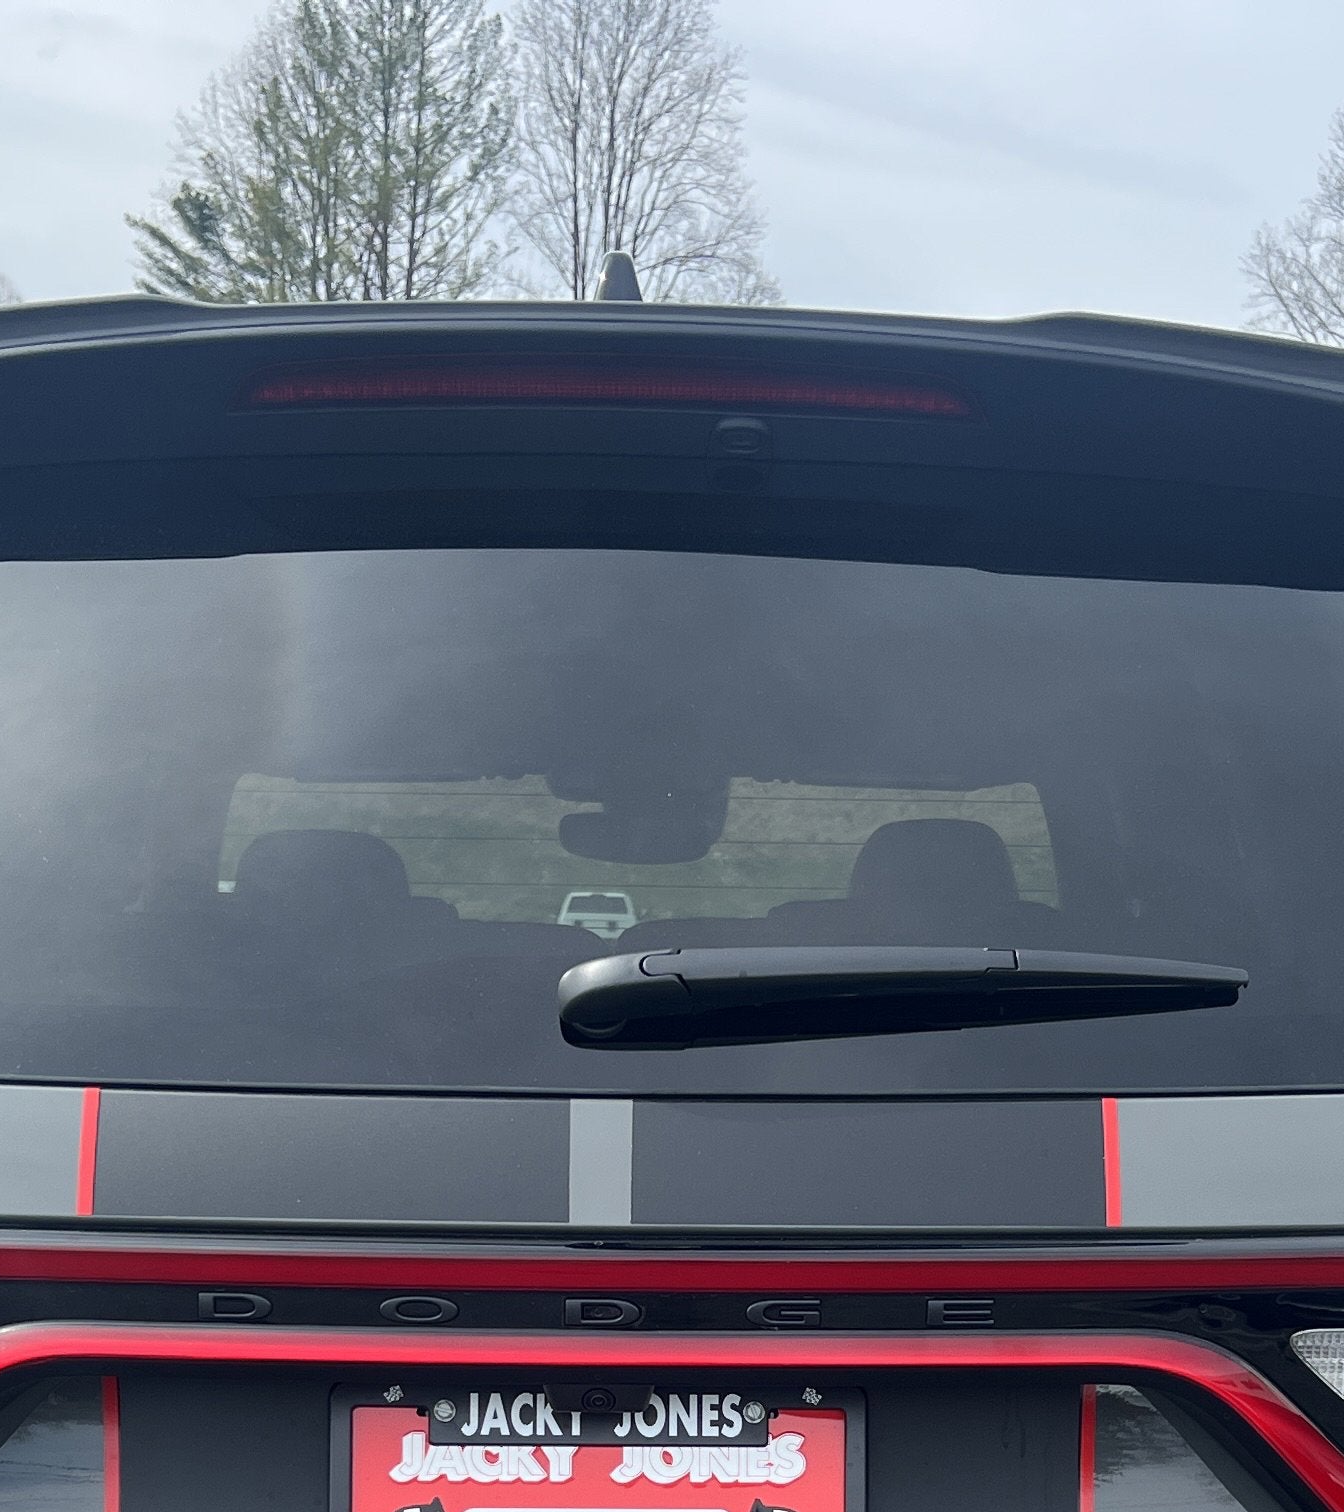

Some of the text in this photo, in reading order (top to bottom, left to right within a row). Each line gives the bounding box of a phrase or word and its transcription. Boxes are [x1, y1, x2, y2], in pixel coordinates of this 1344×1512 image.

[197, 1291, 996, 1328] DODGE
[613, 1393, 744, 1438] JONES
[388, 1431, 807, 1484] JACKY JONES
